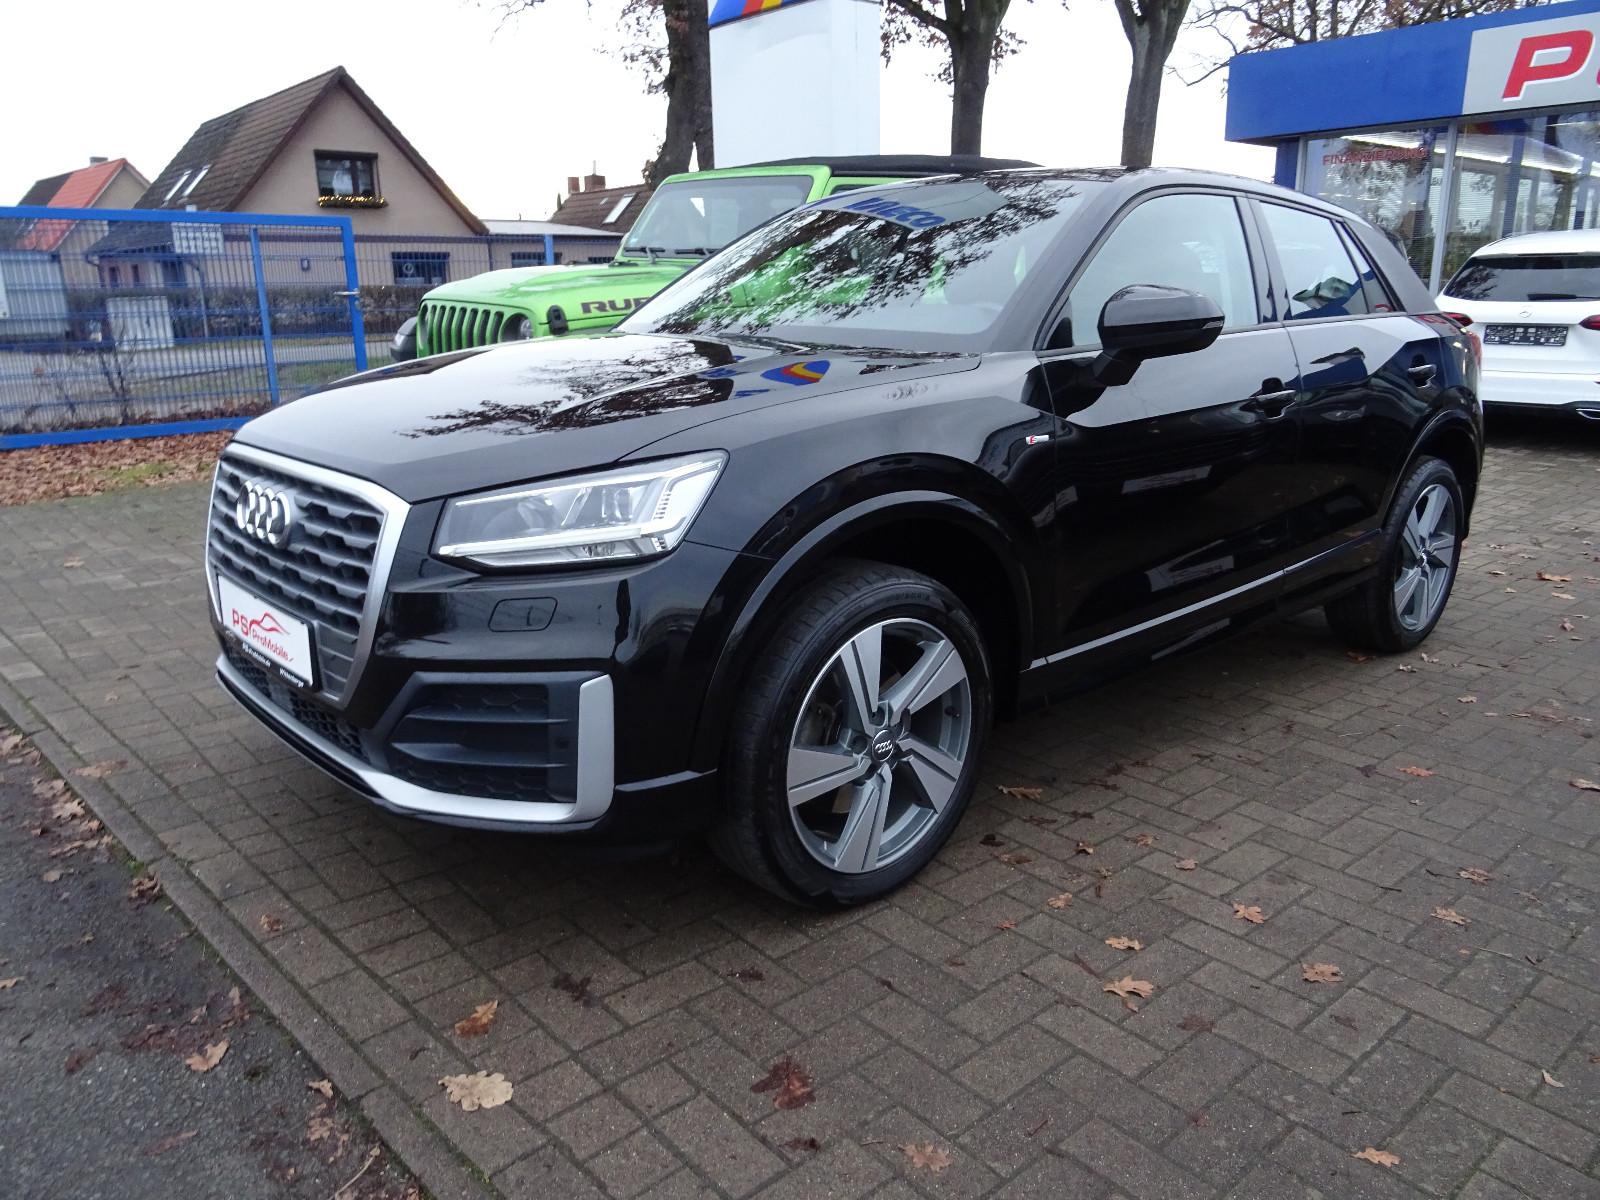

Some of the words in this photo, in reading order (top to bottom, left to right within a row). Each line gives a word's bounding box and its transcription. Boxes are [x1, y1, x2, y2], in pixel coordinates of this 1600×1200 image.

[1502, 30, 1600, 102] P
[1323, 147, 1428, 166] FINANZIERUNG
[232, 608, 249, 637] PS
